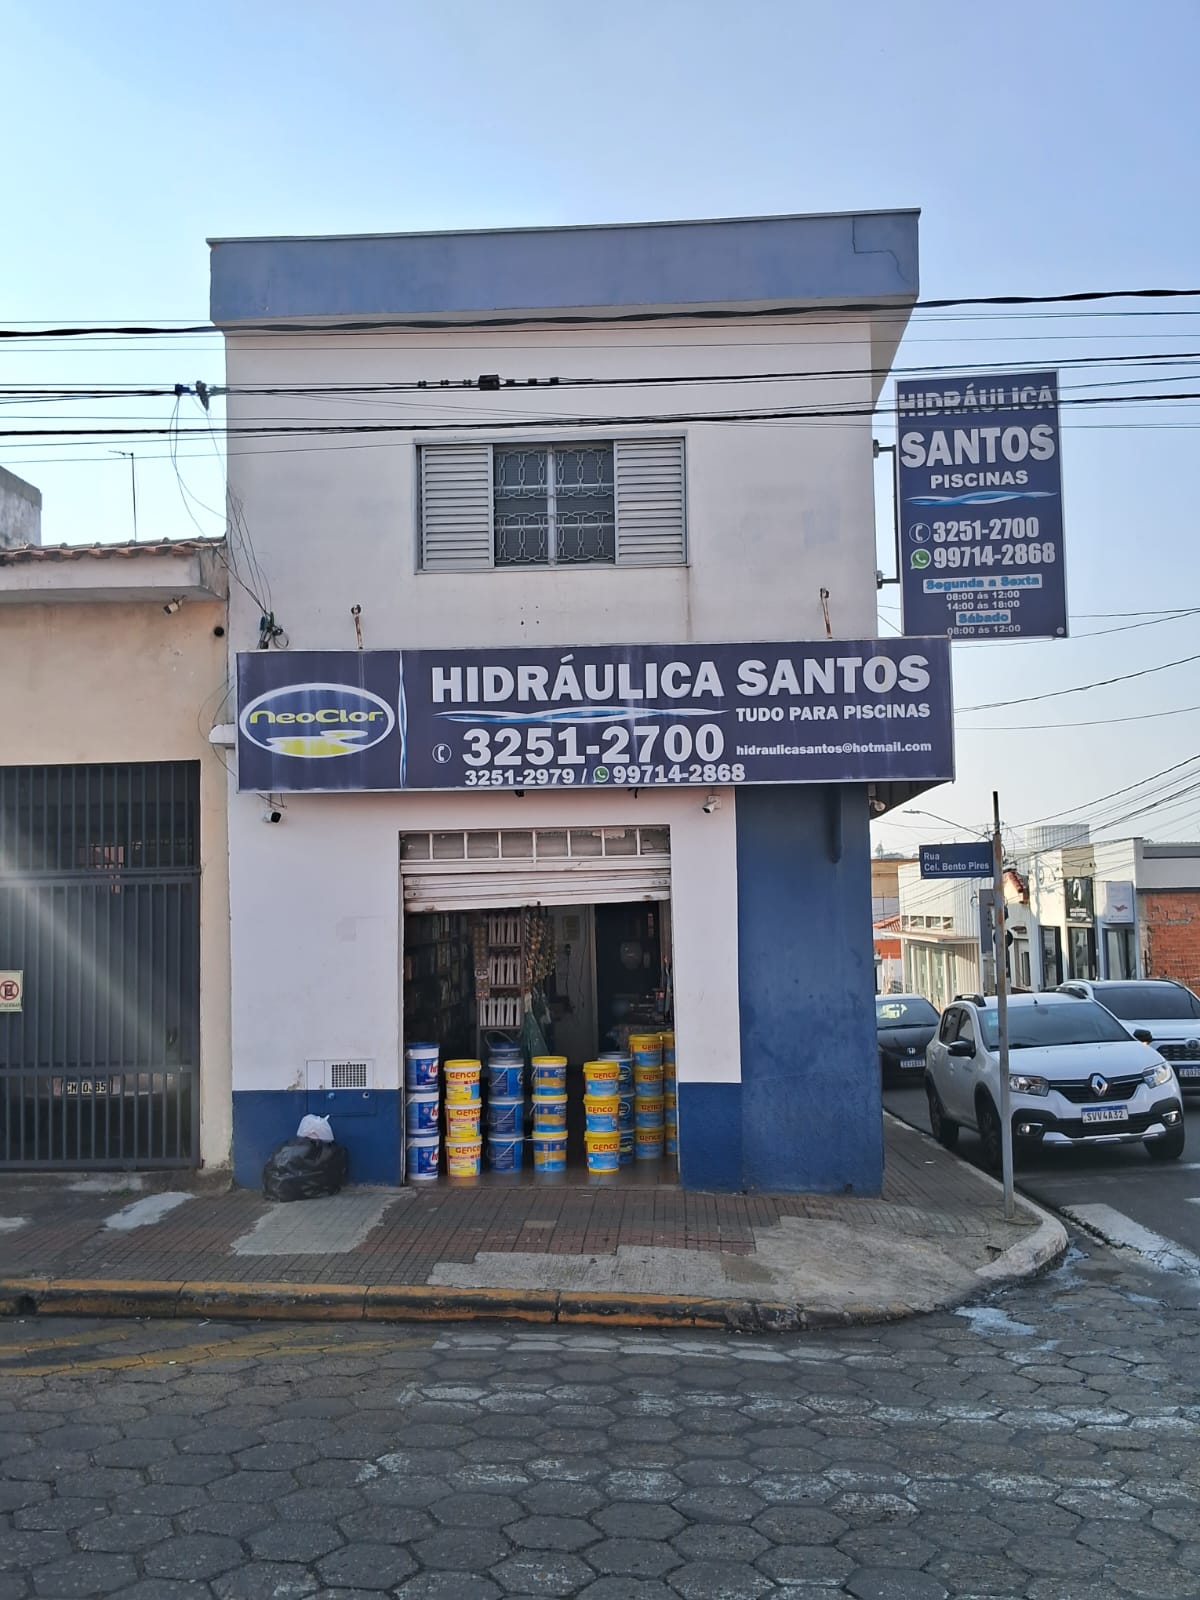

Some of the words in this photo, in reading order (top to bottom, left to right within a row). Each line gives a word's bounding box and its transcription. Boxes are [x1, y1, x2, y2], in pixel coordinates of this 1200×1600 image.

[899, 382, 1055, 417] HIDRÁULICA
[901, 424, 1055, 468] SANTOS
[930, 470, 1028, 489] PISCINAS
[932, 517, 1040, 543] 3251-2700
[933, 542, 1055, 568] 99714-2868
[926, 578, 984, 591] Segunda
[988, 579, 996, 587] a
[1001, 576, 1040, 587] Sexta
[946, 593, 974, 601] 08:00
[992, 590, 1020, 599] 12:00
[946, 602, 974, 610] 14:00
[958, 613, 1009, 624] Sábado
[947, 626, 975, 635] 08:00
[993, 624, 1021, 633] 12:00
[432, 654, 725, 703] HIDRÁULICA
[736, 654, 930, 697] SANTOS
[736, 707, 784, 722] TUDO
[789, 706, 838, 721] PARA
[844, 703, 930, 719] PISCINAS
[462, 723, 725, 766] 3251-2700
[736, 742, 931, 755] hidraulicasantos@hotmail.com
[465, 768, 575, 786] 3251-2979
[613, 764, 746, 784] 99714-2868
[924, 852, 940, 860] Rua
[924, 863, 940, 871] Cel.
[942, 862, 966, 871] Bento
[968, 861, 990, 870] Pires
[450, 1071, 477, 1080] GENCO
[588, 1106, 613, 1115] GENCO
[1086, 1110, 1124, 1122] SVV4A32
[593, 1143, 618, 1152] GENCO
